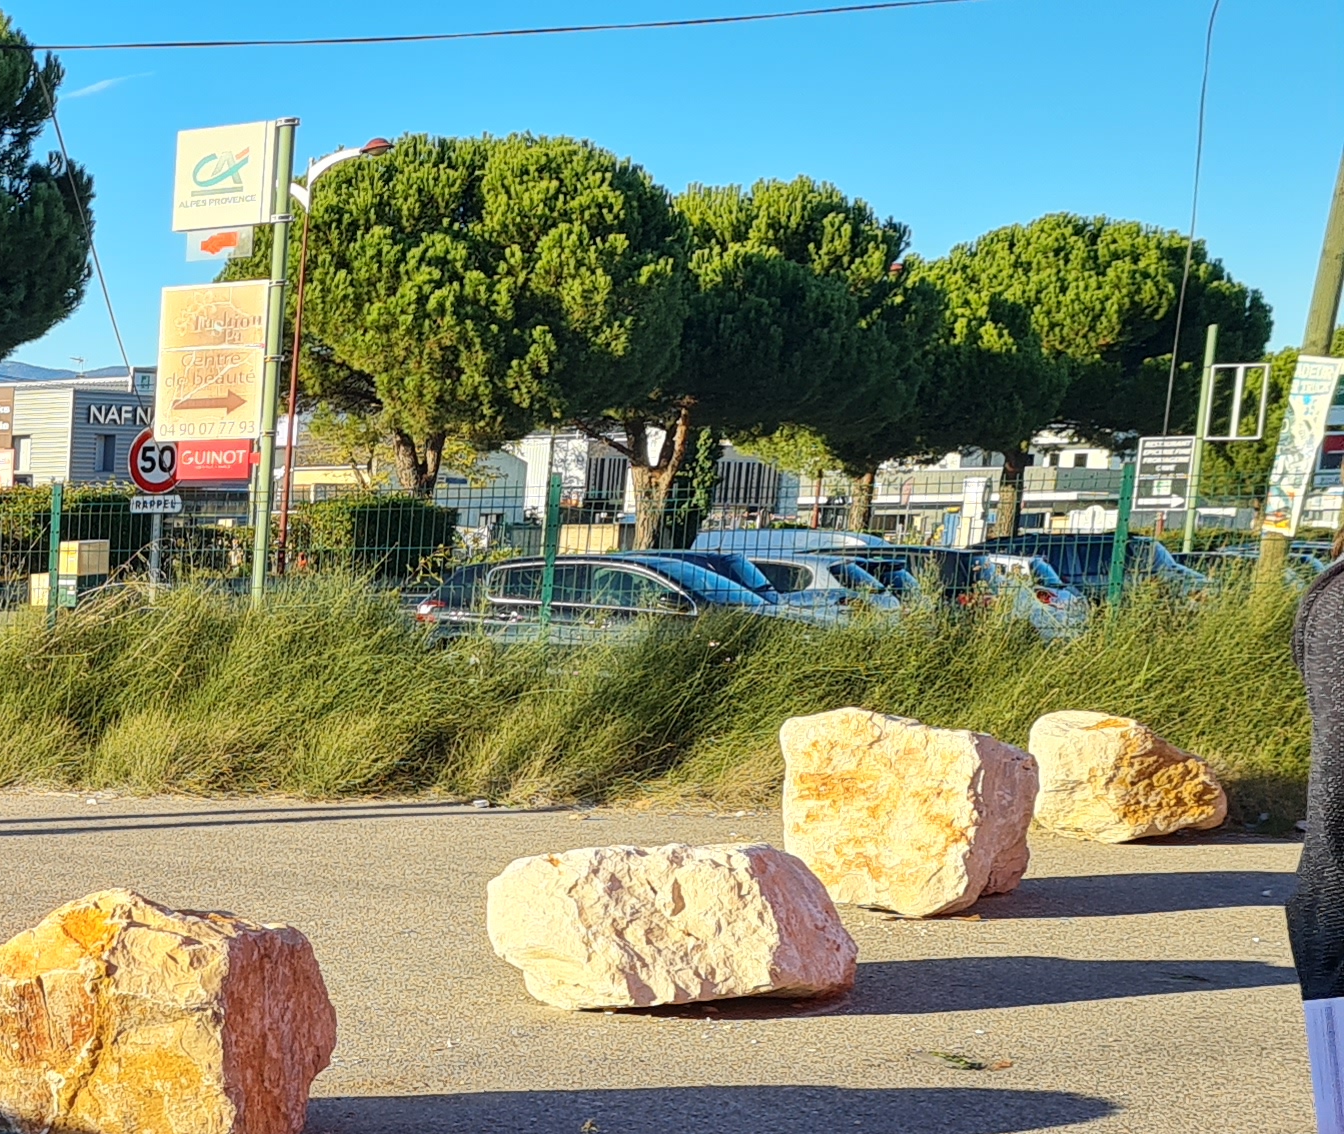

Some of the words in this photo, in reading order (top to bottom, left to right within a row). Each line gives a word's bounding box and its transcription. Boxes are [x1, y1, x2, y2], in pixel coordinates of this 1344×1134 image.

[178, 199, 207, 208] ALPES
[208, 194, 256, 207] PROVENCE
[181, 354, 241, 368] Centre
[165, 373, 187, 388] de
[193, 369, 256, 386] beauté
[89, 404, 133, 425] NAF
[160, 423, 176, 436] 04
[179, 422, 196, 436] 90
[198, 422, 215, 435] 07
[219, 421, 235, 434] 77
[239, 420, 255, 434] 93
[140, 445, 175, 474] 50
[181, 449, 247, 465] GUINOT
[135, 499, 175, 510] RAPPEL
